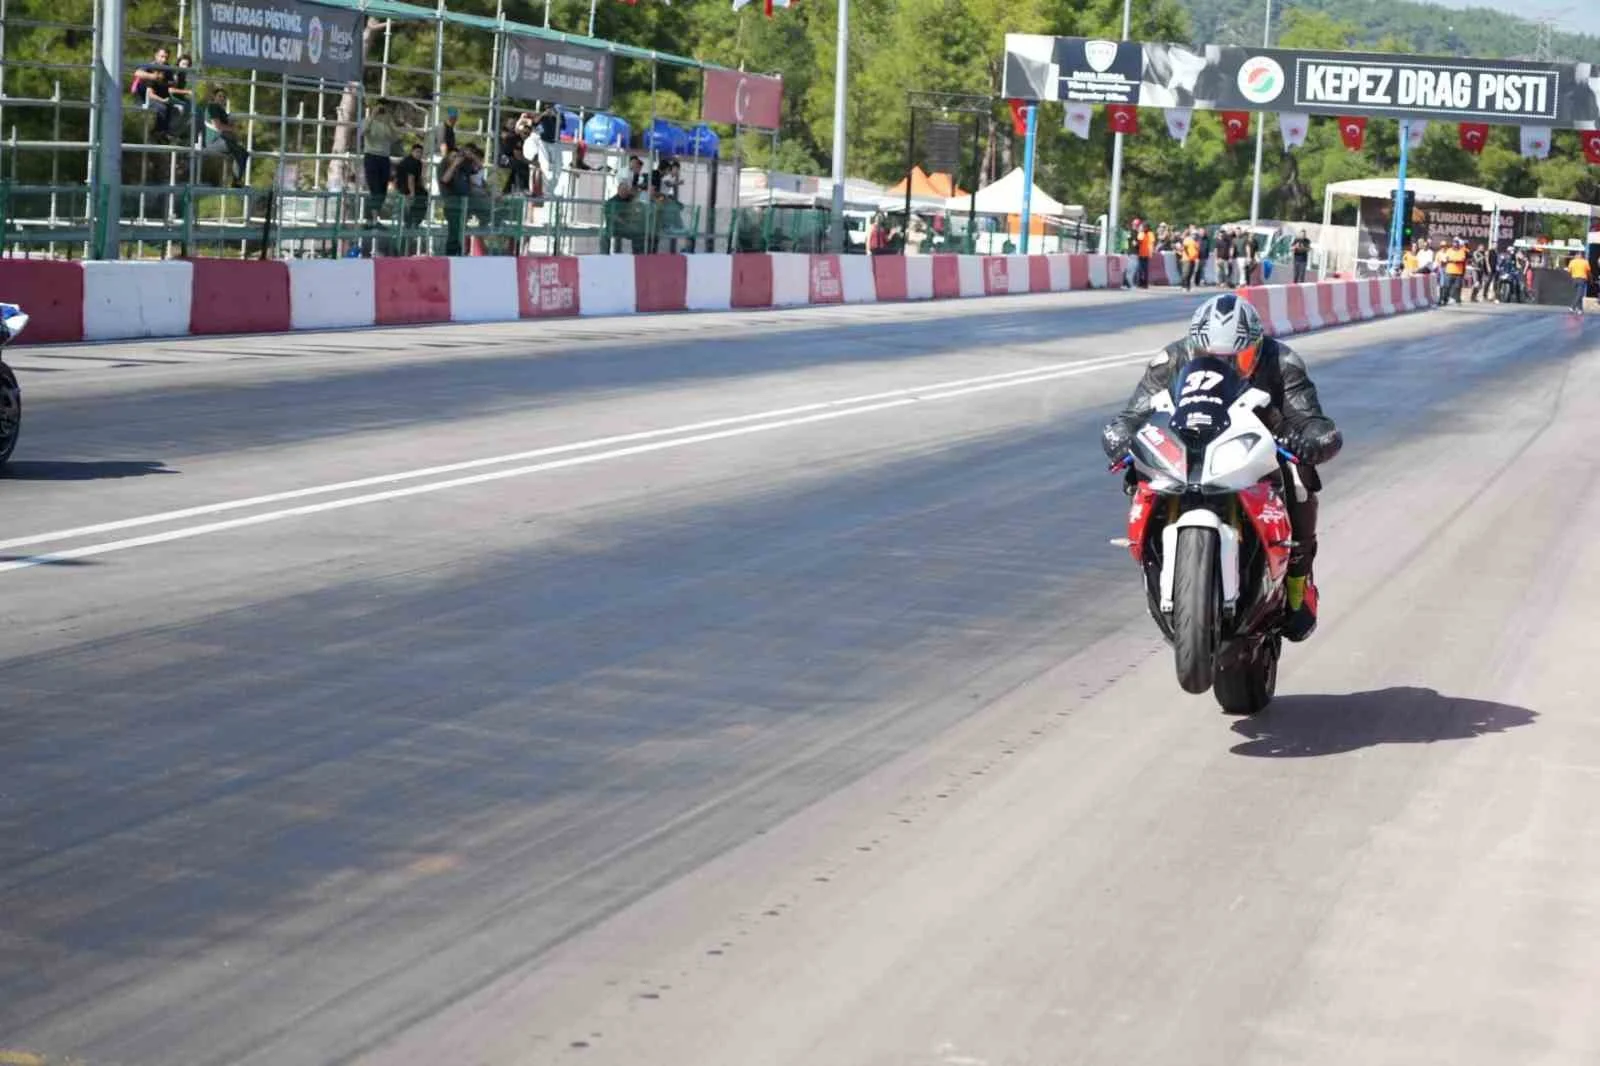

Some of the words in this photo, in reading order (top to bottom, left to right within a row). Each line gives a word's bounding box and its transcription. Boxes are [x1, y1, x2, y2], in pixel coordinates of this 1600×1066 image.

[210, 29, 260, 58] HAYIRLI
[261, 34, 303, 63] OLSUN
[1306, 64, 1393, 104] KEPEZ
[1398, 69, 1472, 109] DRAG
[1181, 370, 1224, 395] 37
